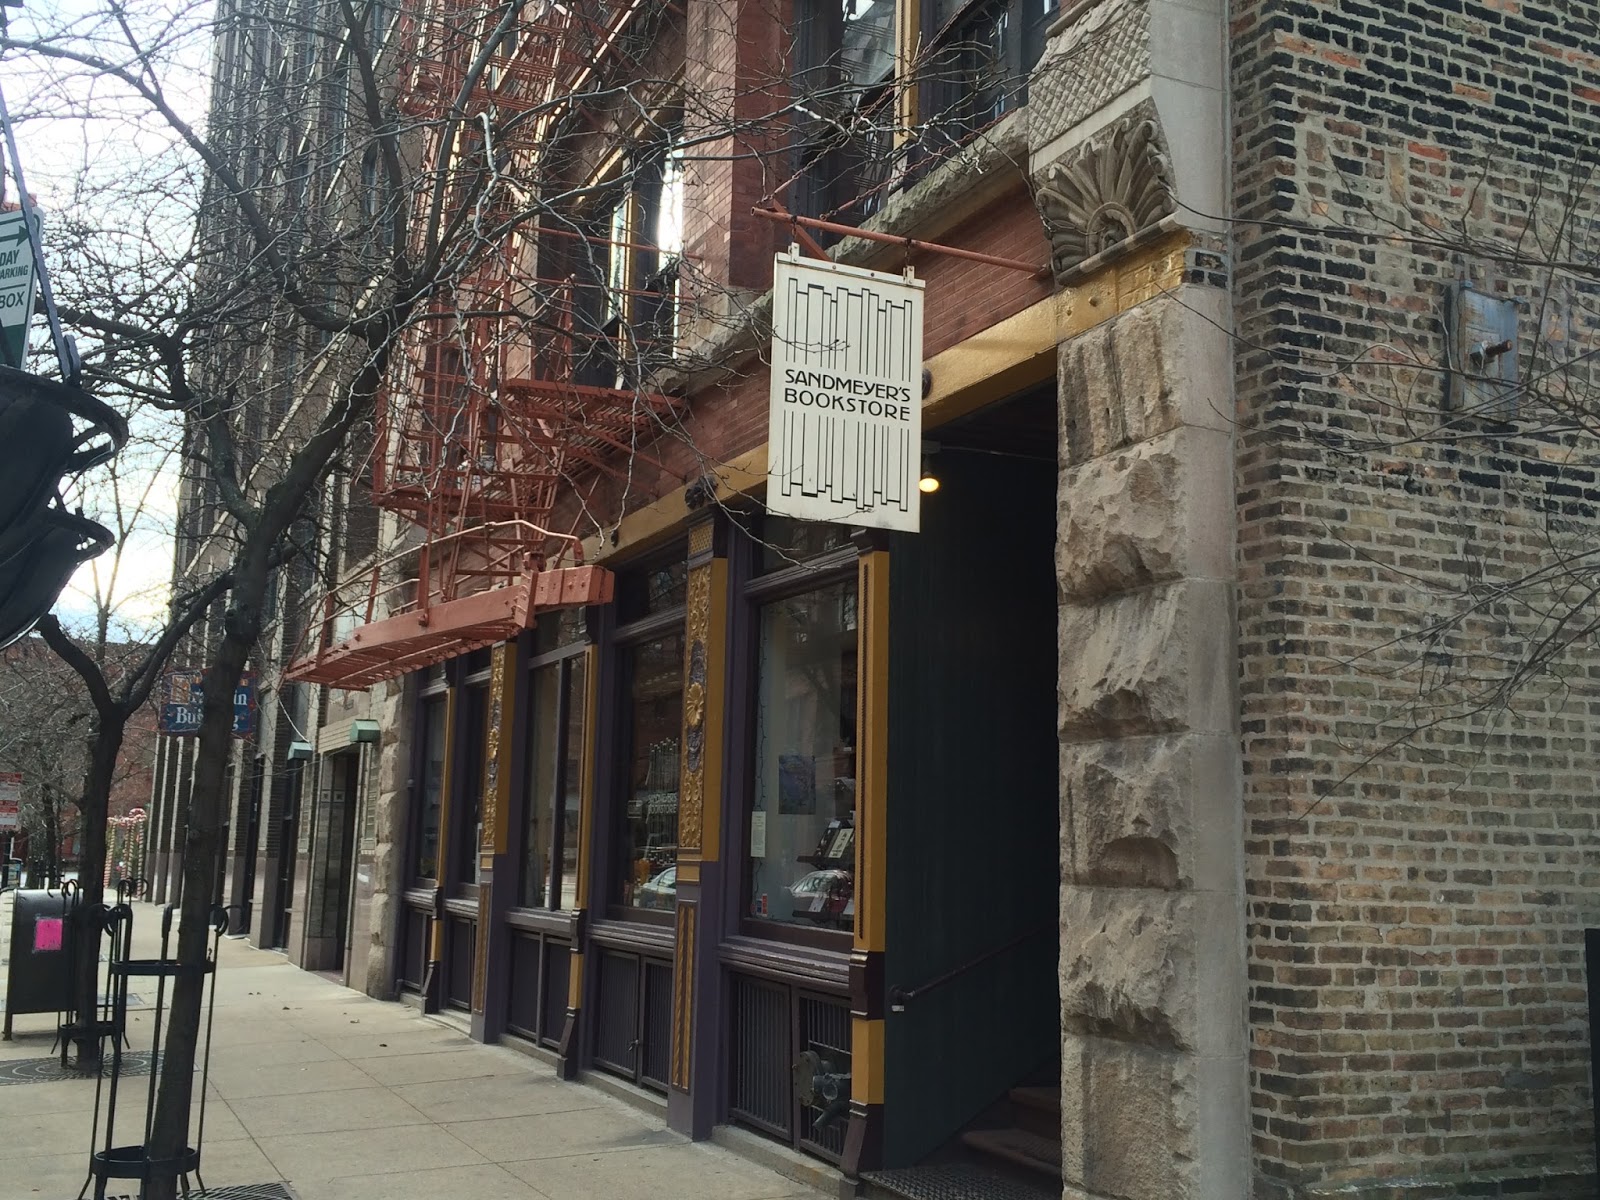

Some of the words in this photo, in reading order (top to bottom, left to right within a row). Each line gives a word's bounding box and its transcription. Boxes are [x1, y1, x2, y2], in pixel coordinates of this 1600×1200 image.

[0, 291, 25, 309] BOX
[785, 368, 911, 402] SANDMEYER'S
[784, 387, 911, 421] BOOKSTORE
